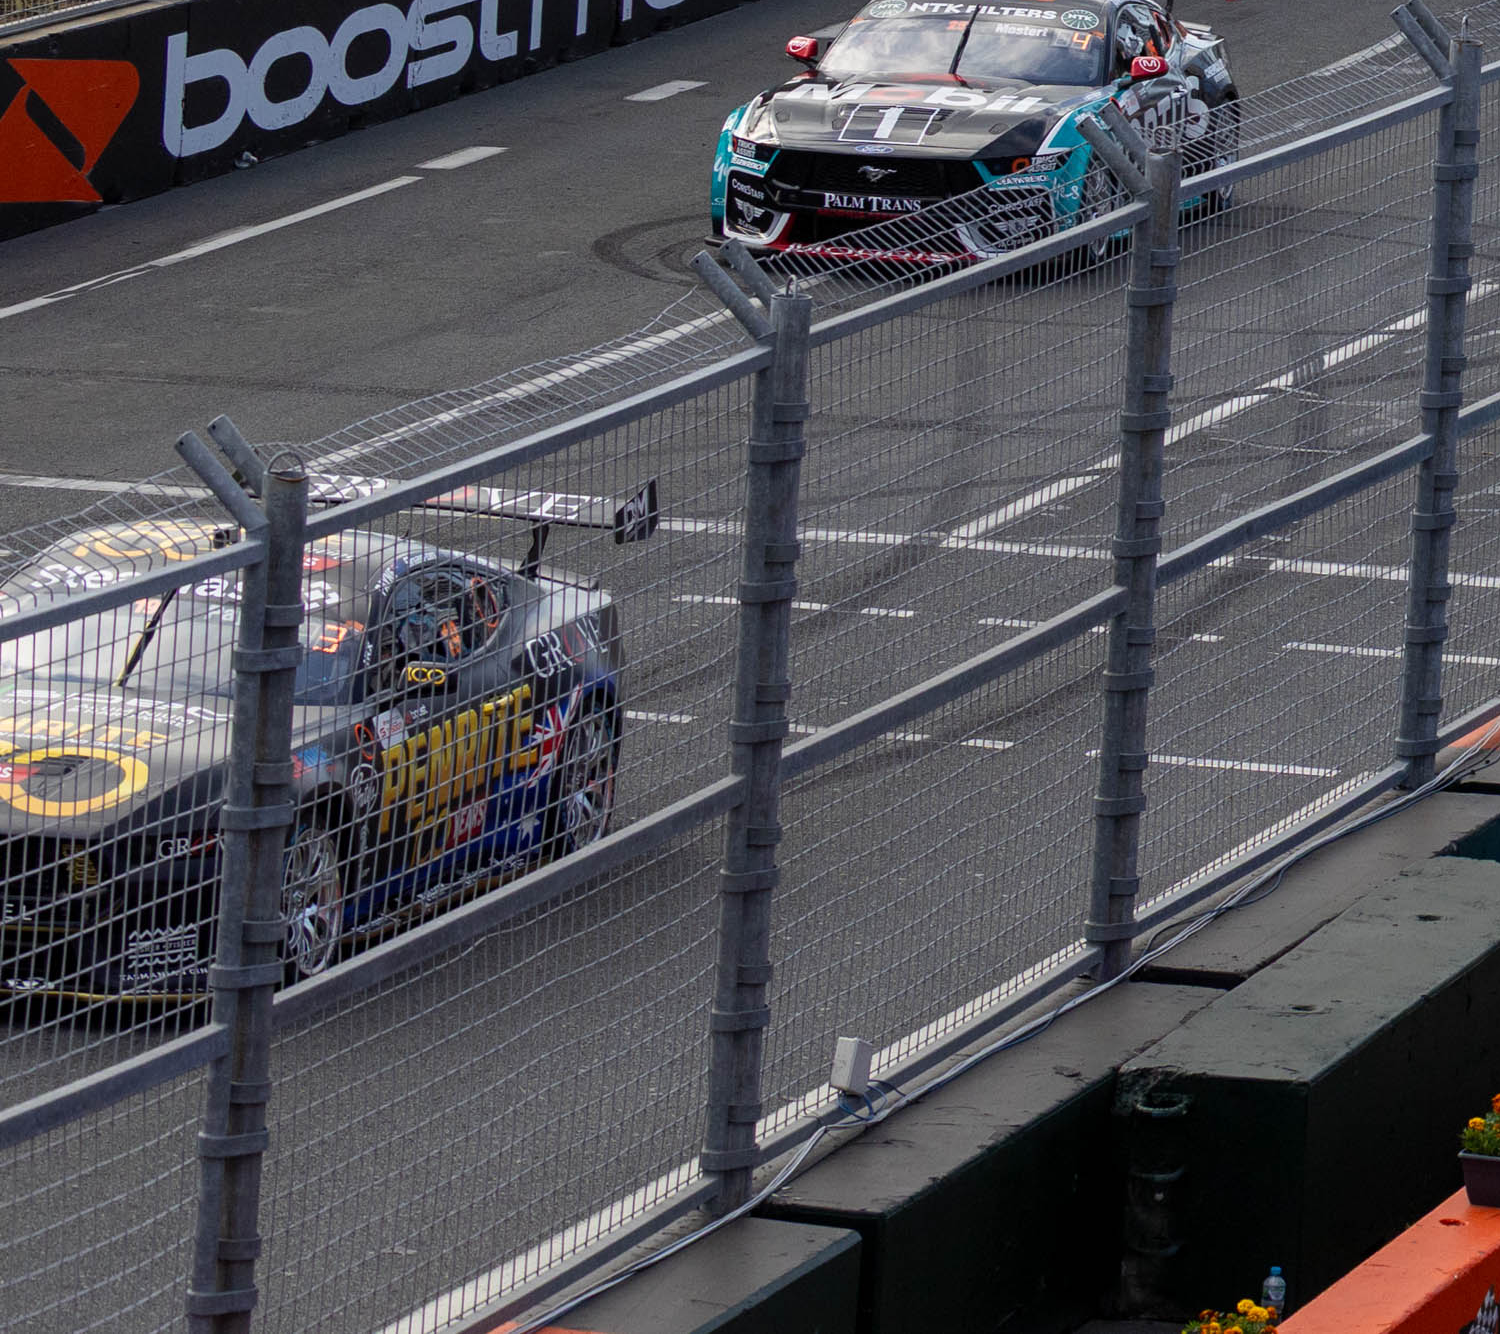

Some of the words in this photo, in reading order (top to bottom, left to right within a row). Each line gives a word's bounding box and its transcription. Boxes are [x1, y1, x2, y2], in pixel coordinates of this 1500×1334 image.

[908, 1, 964, 15] NTK
[965, 3, 1058, 21] FILTERS
[993, 22, 1048, 38] Mostert
[784, 82, 1043, 114] Mobil
[872, 106, 905, 140] 1
[823, 191, 865, 211] PALM
[868, 195, 922, 213] TRANS
[380, 683, 539, 834] PENRITE
